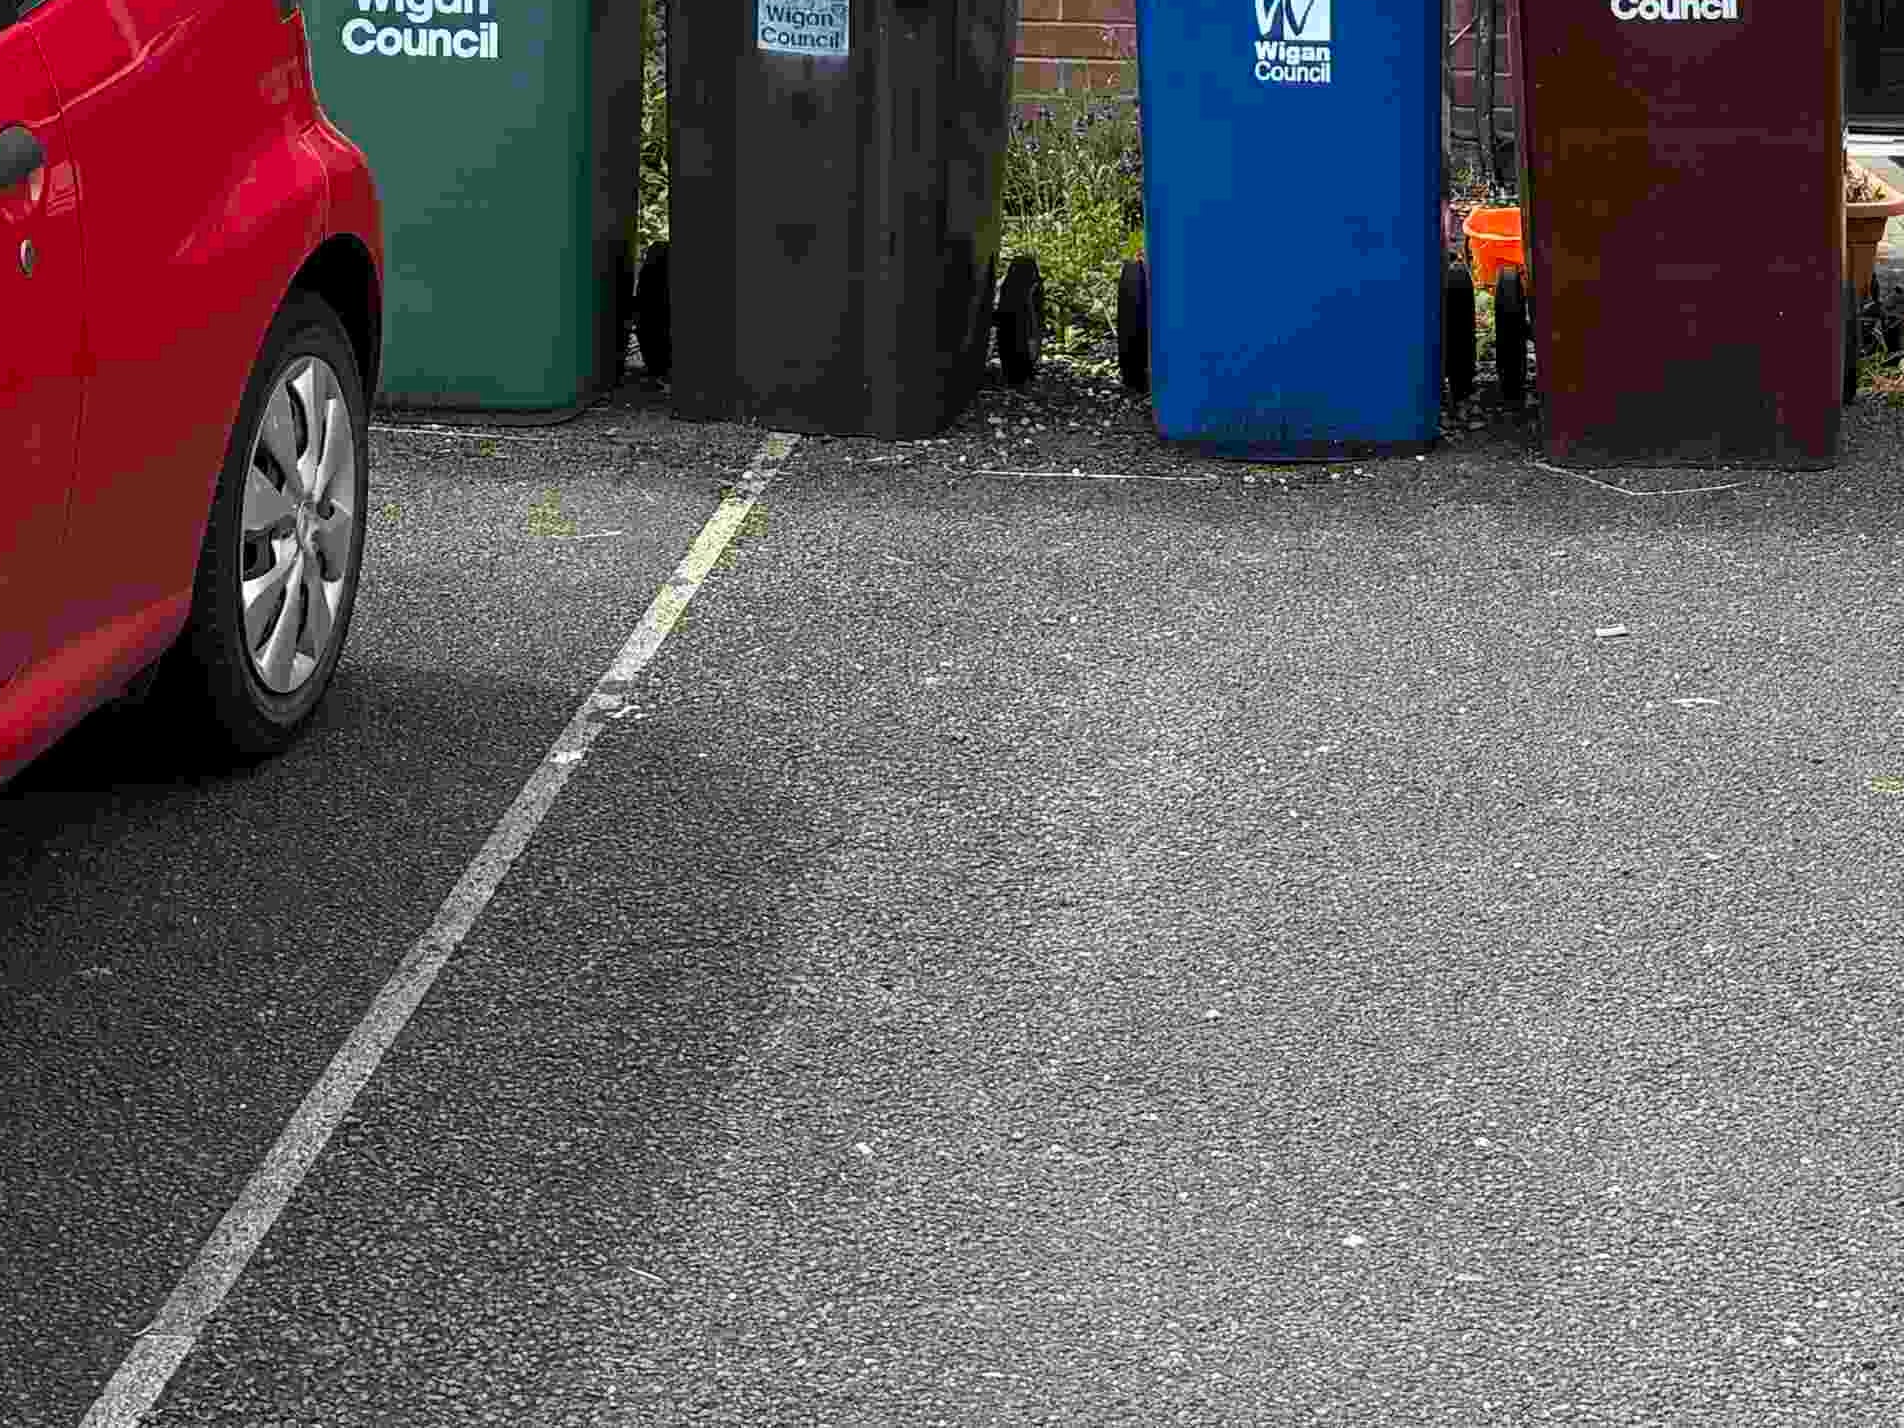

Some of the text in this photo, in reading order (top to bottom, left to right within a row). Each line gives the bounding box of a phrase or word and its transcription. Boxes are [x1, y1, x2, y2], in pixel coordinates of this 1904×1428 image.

[766, 4, 834, 30] Wigan
[342, 18, 499, 59] Council
[761, 26, 840, 49] Council
[1254, 40, 1331, 65] Wigan
[1254, 60, 1331, 83] Council
